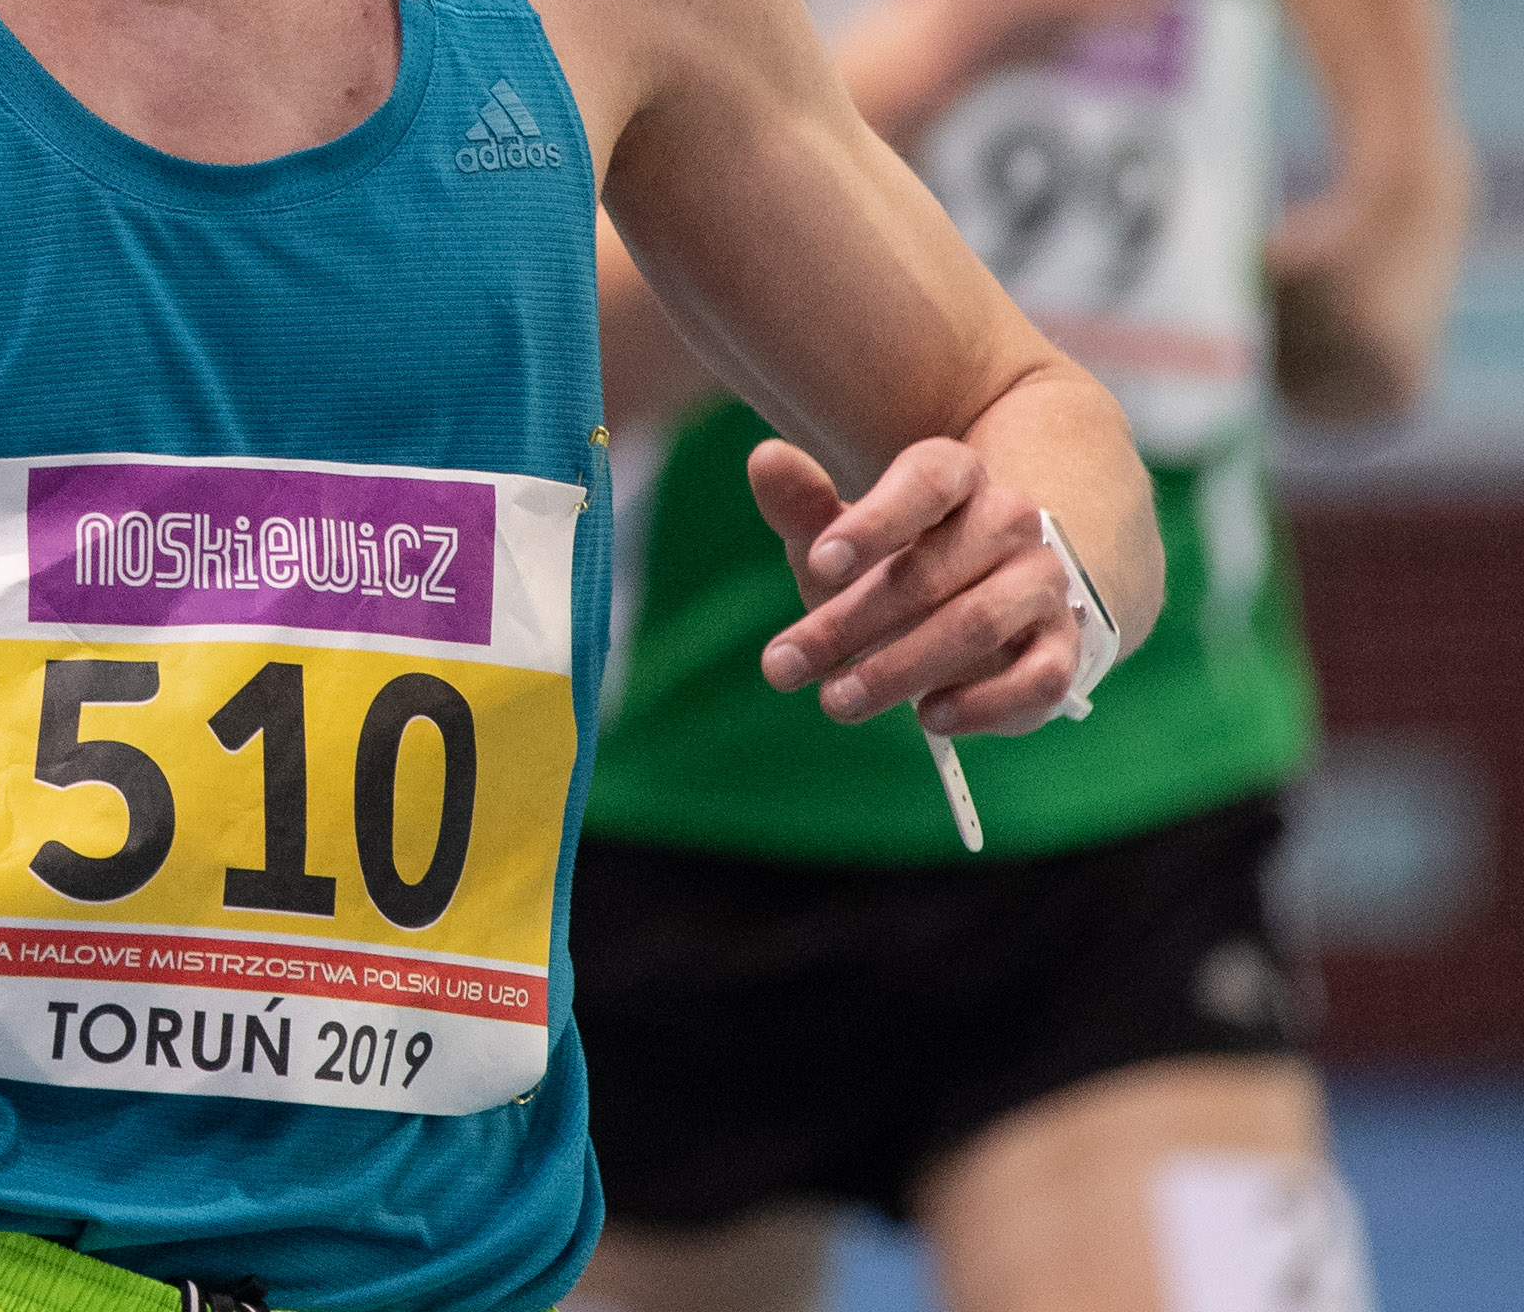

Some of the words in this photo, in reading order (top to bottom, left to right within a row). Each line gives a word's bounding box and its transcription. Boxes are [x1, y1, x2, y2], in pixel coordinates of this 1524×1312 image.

[455, 137, 562, 174] adidas
[27, 658, 477, 931] 510
[20, 943, 142, 969] HALOWE
[149, 950, 357, 986] MISTRZOSTWA
[363, 968, 440, 996] POLSKI
[445, 978, 483, 1002] U18
[487, 983, 529, 1009] U20
[48, 996, 291, 1076] TORUŃ
[315, 1021, 434, 1089] 2019
